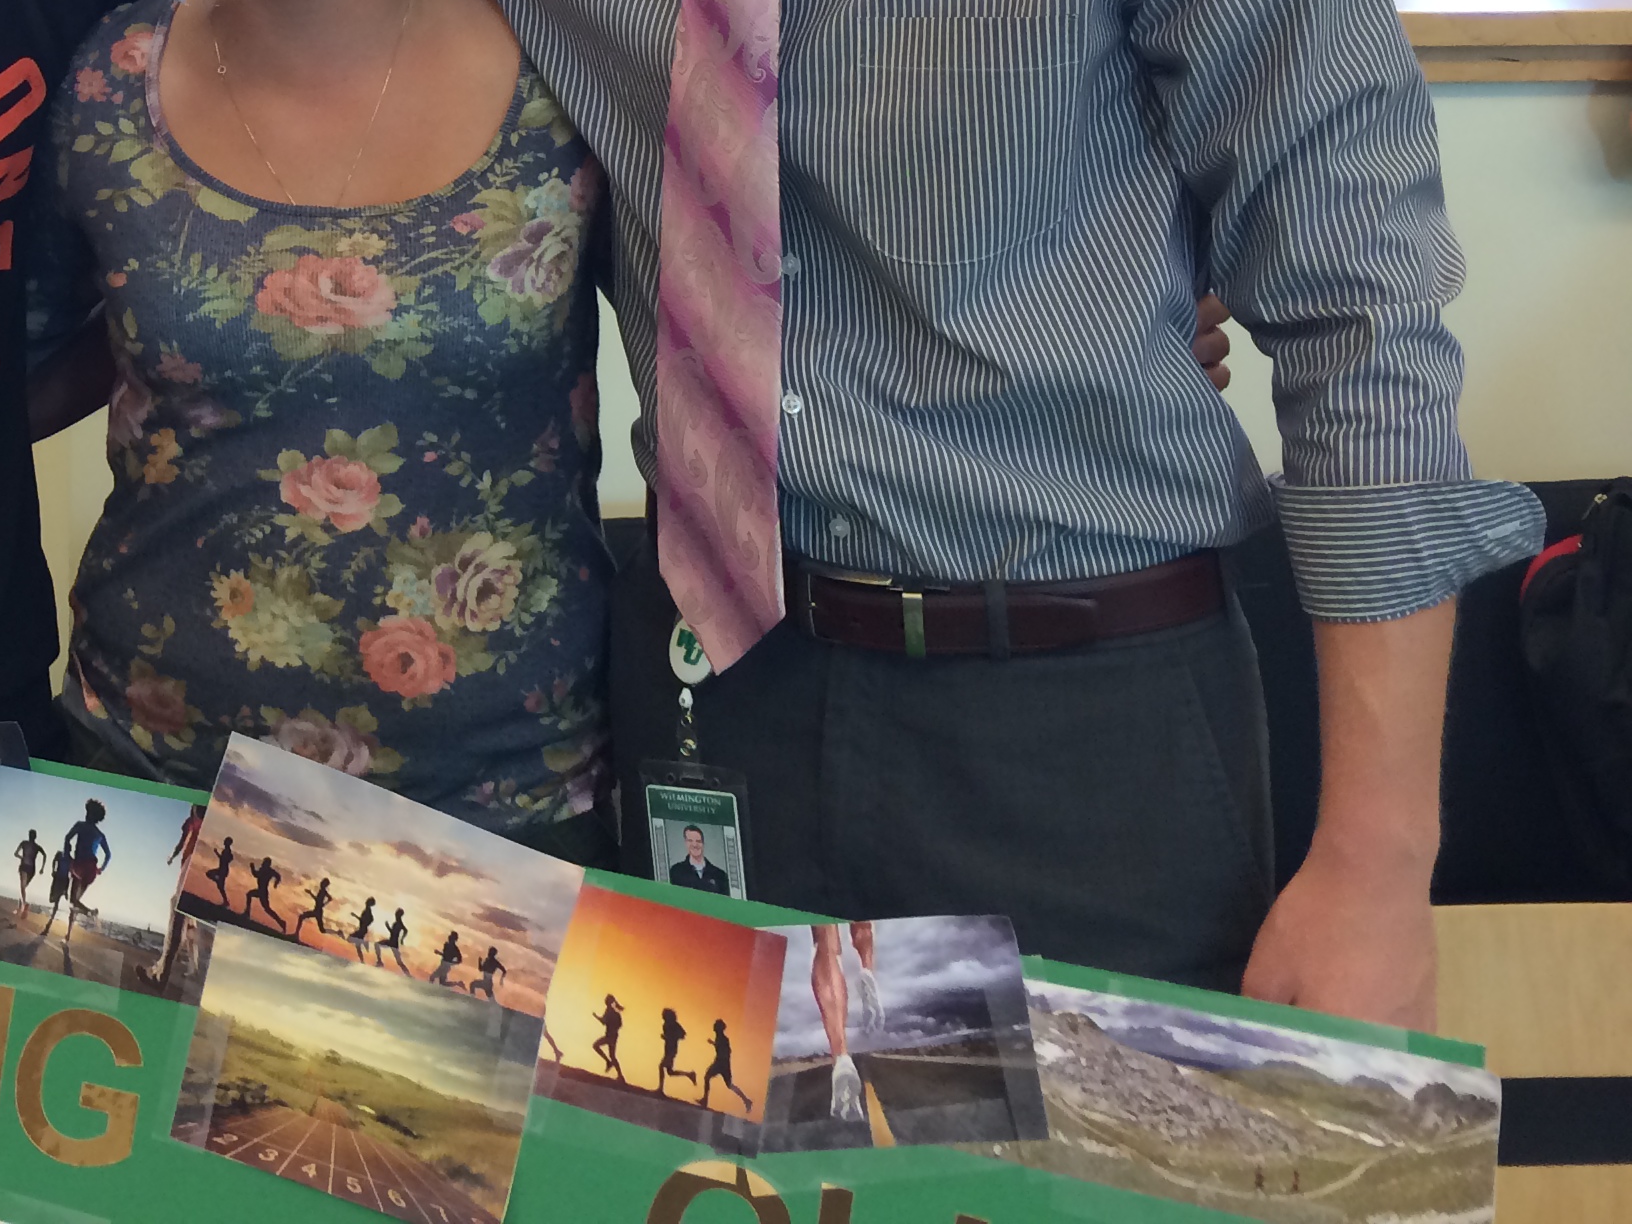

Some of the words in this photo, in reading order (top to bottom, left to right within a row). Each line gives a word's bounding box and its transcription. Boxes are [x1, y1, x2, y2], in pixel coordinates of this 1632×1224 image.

[660, 791, 722, 806] WILMINGTON
[667, 802, 717, 815] UNIVERSITY
[258, 1148, 279, 1162] 3
[301, 1162, 318, 1179] 4
[346, 1176, 363, 1194] 5
[387, 1189, 407, 1209] 6
